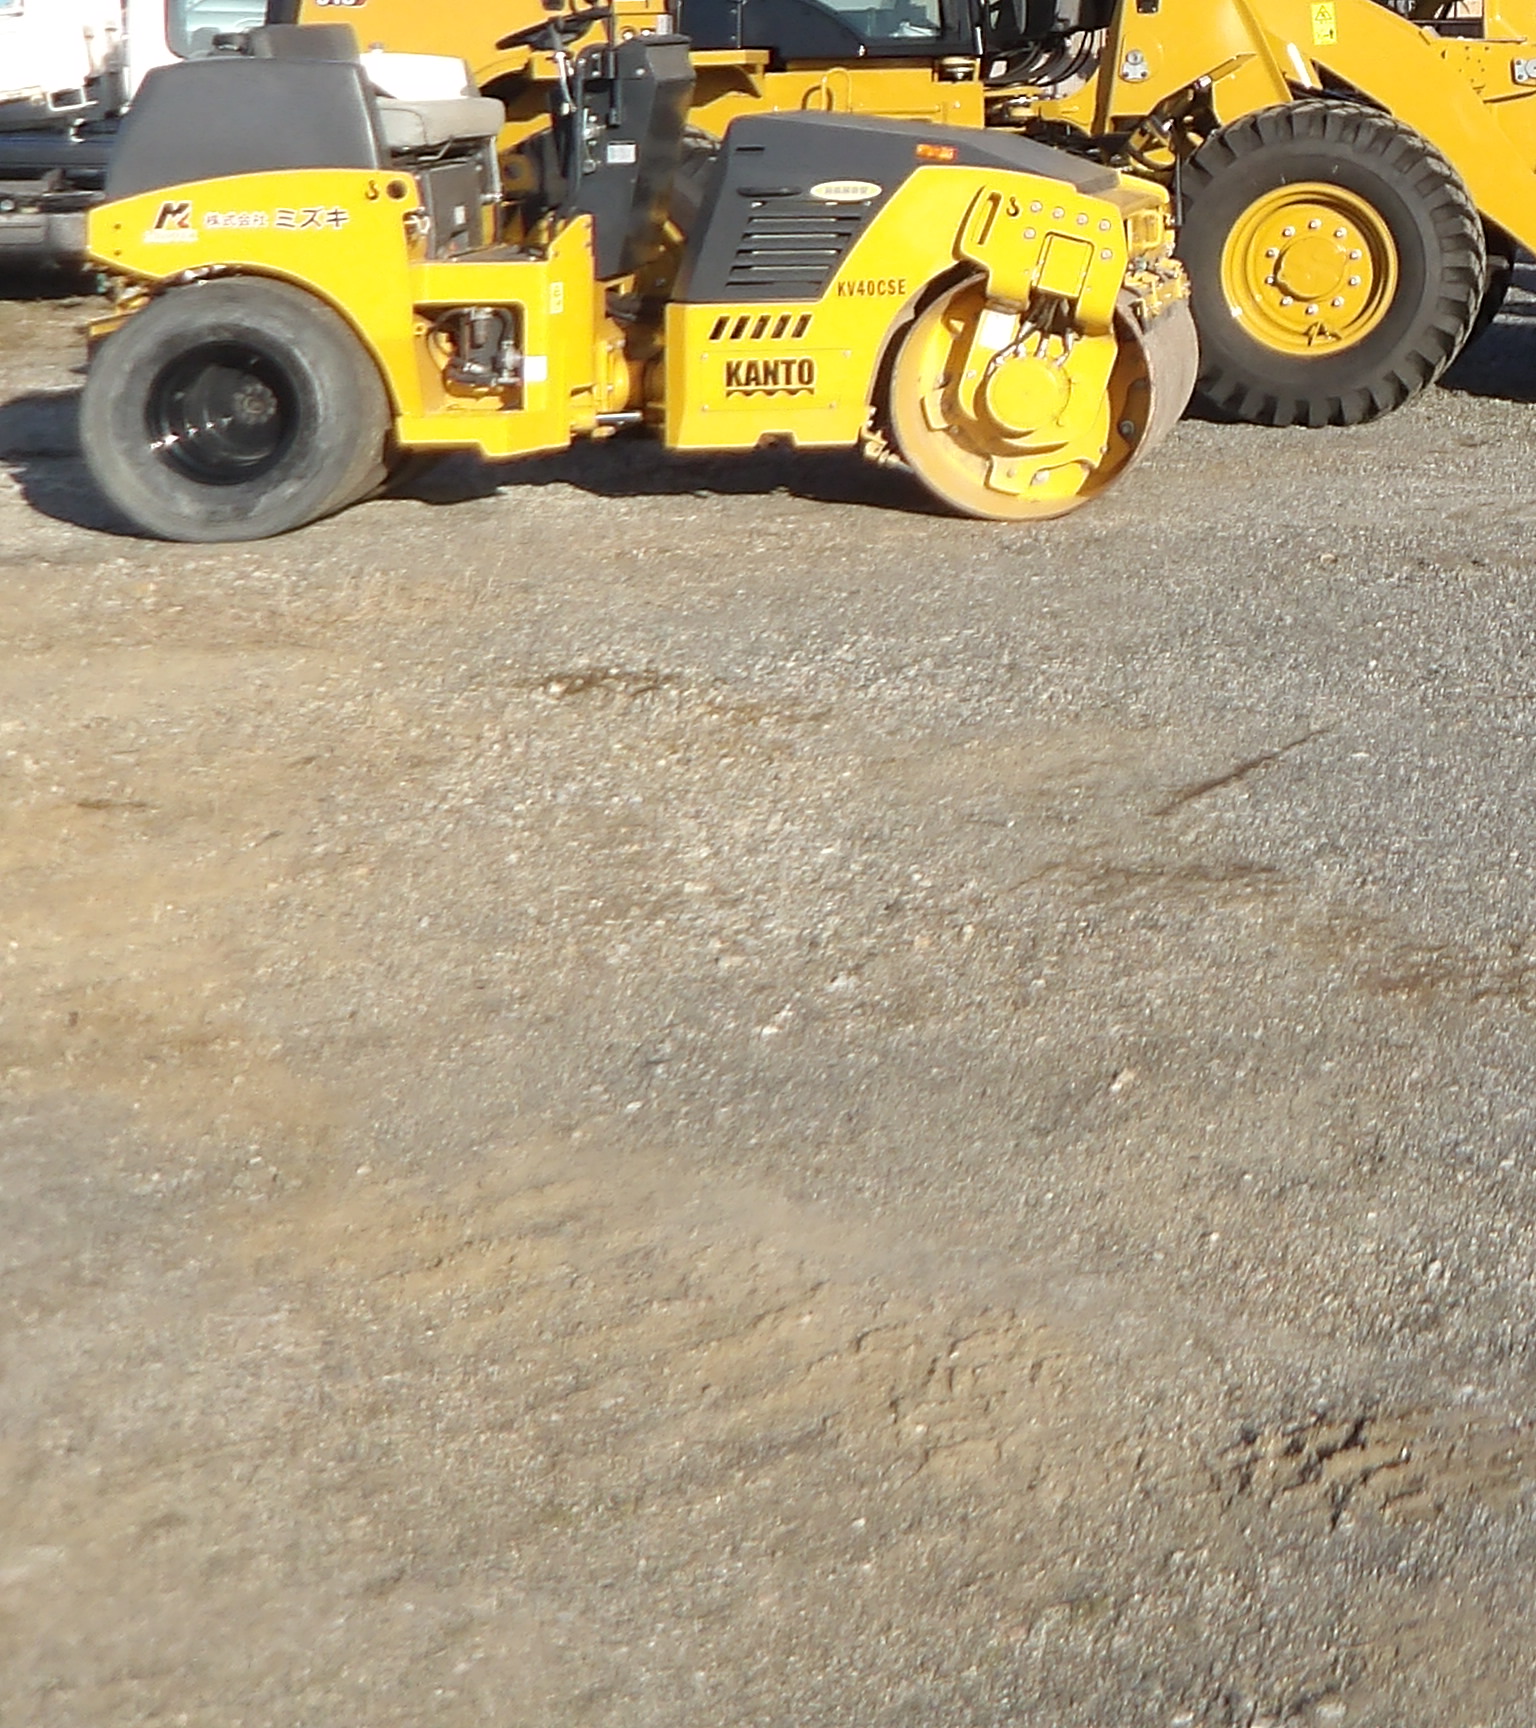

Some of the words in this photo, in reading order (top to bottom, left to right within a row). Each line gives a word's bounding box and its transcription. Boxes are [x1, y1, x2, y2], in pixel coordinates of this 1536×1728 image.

[275, 206, 351, 229] ミズキ
[837, 278, 906, 297] KV40CSE
[725, 358, 815, 387] KANTO
